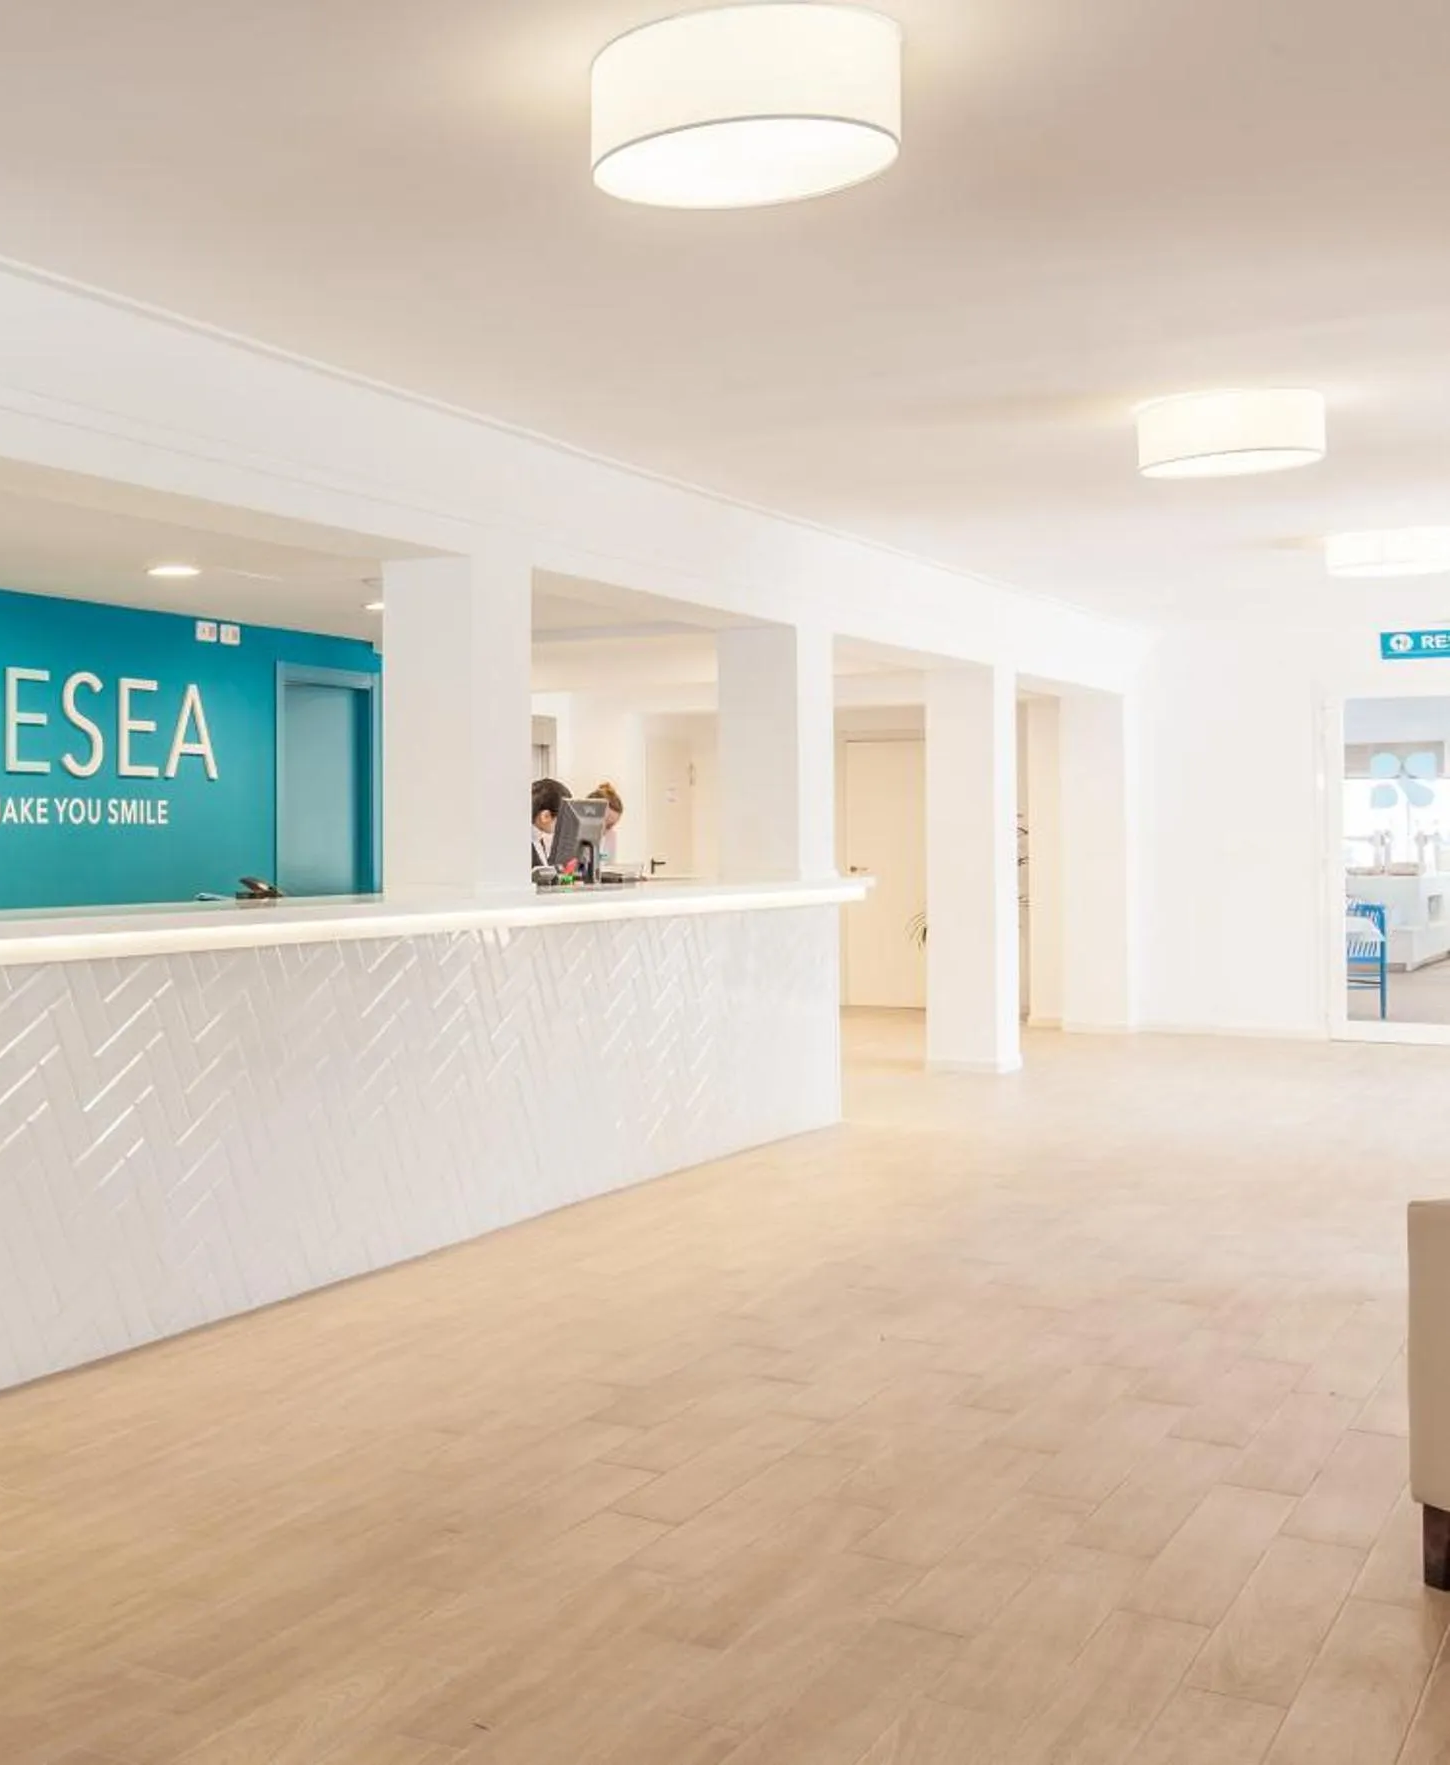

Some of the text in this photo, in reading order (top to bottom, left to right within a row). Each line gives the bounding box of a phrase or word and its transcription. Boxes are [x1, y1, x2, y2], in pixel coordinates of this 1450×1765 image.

[1420, 635, 1450, 649] RE
[54, 798, 101, 825] YOU
[107, 799, 169, 826] SMILE
